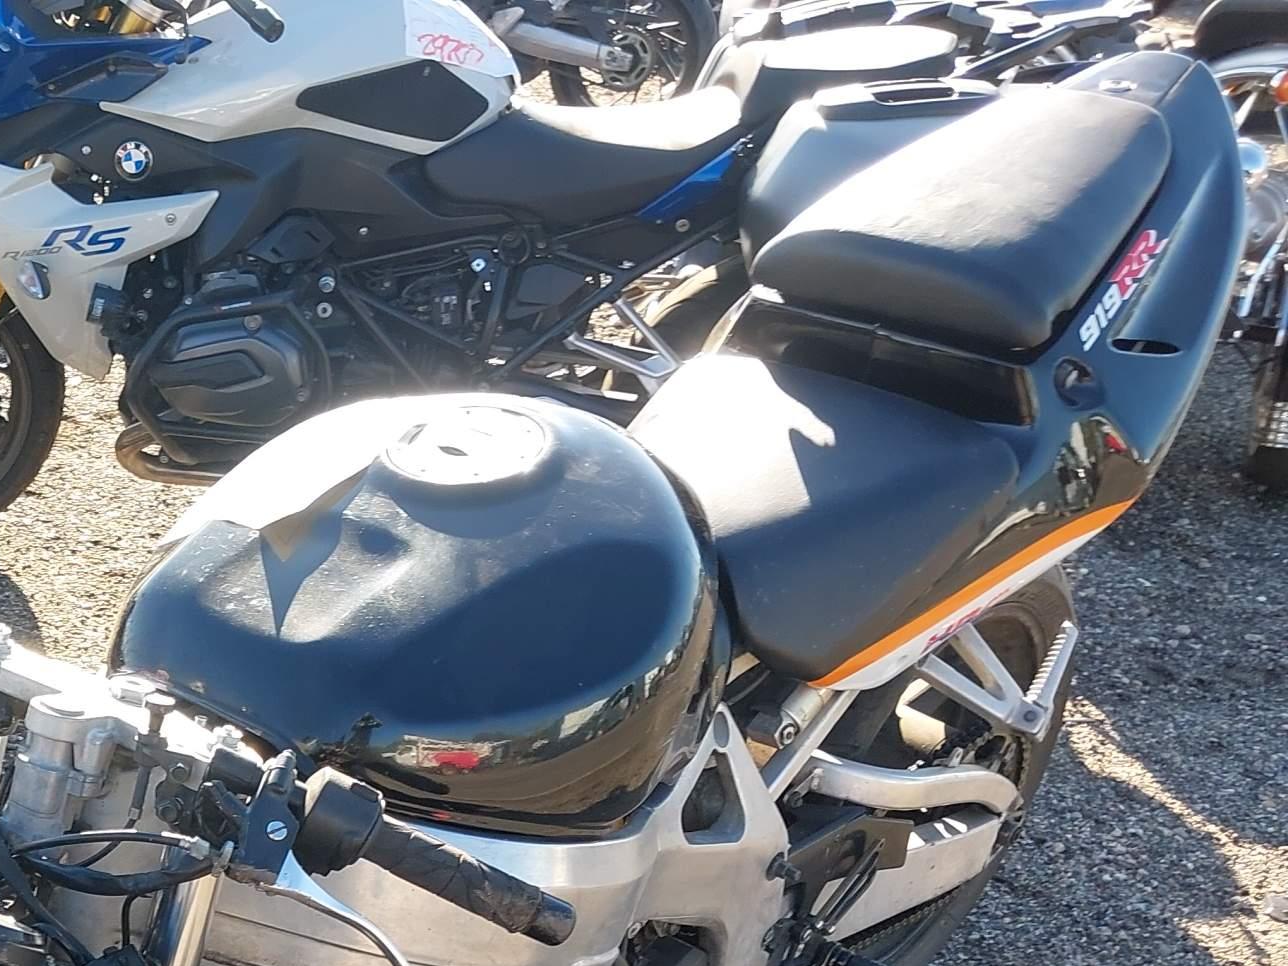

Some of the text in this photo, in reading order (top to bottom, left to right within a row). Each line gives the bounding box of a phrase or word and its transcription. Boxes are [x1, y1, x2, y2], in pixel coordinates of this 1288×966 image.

[1, 246, 63, 261] R1200
[41, 225, 132, 256] RS
[1078, 229, 1169, 352] 919RR
